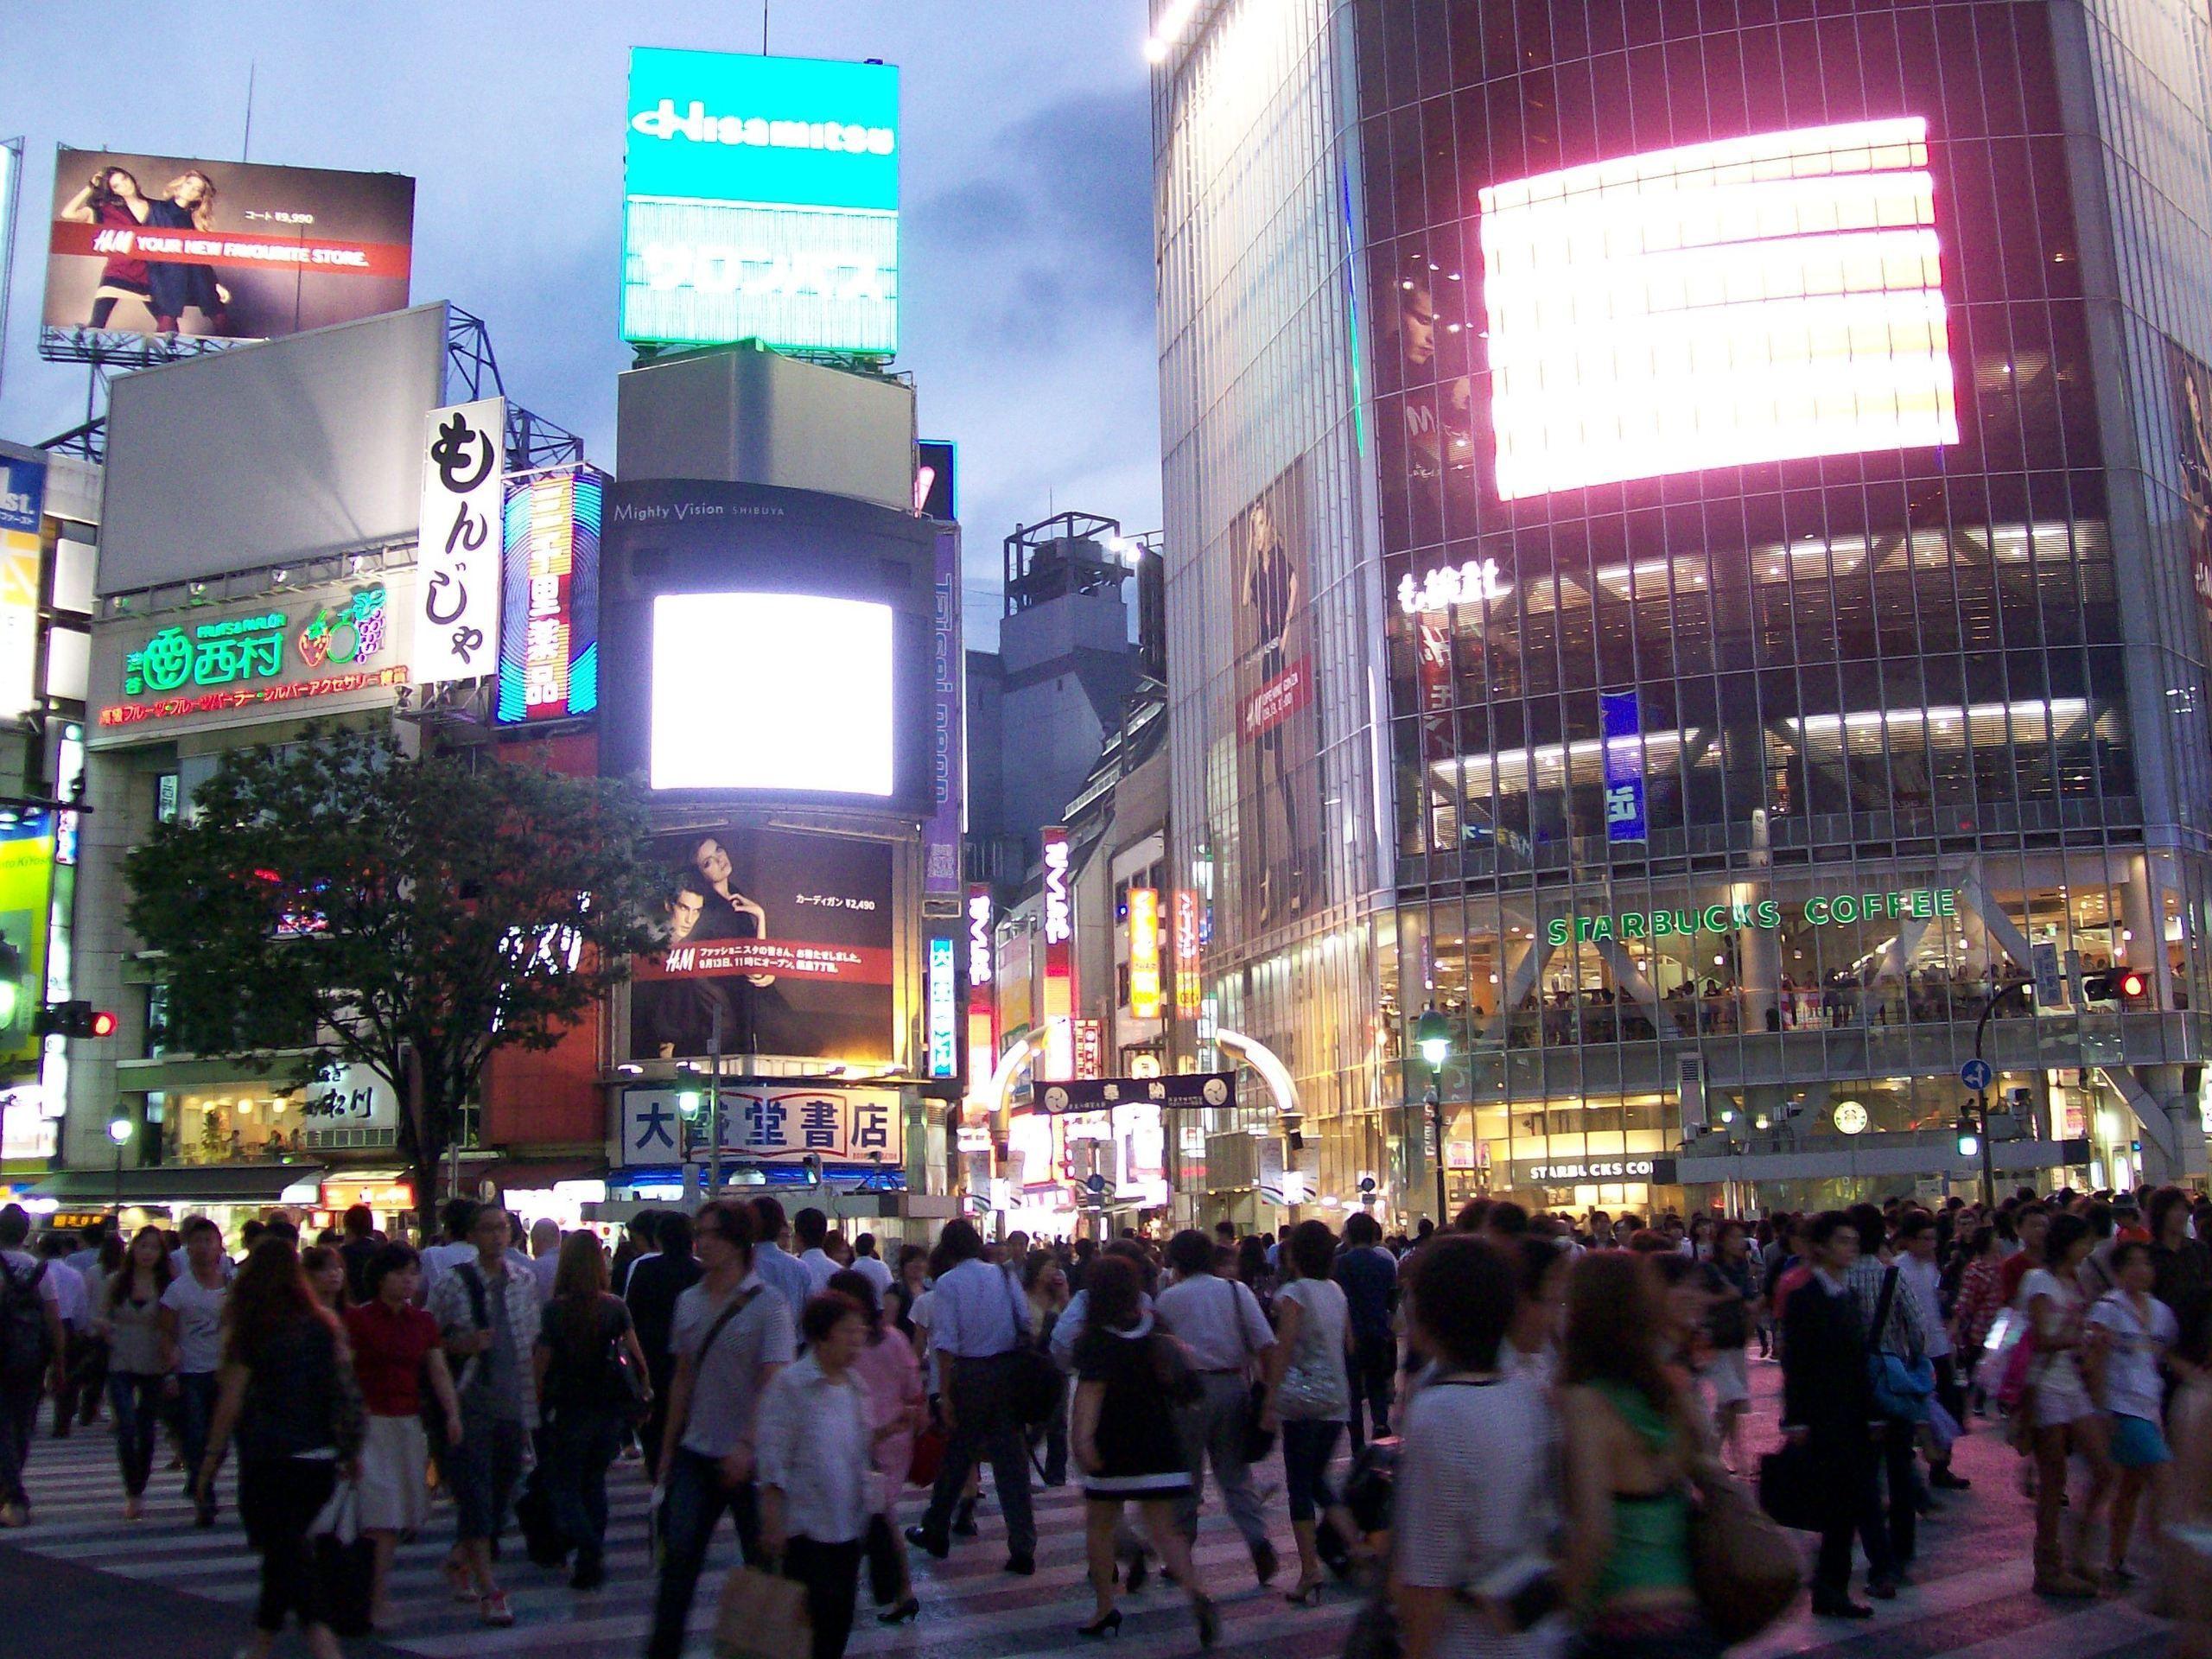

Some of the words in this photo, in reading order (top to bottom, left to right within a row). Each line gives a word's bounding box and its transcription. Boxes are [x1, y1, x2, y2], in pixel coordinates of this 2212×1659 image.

[632, 99, 894, 156] Hisamitsu
[245, 210, 271, 221] コート
[137, 236, 183, 254] YOUR
[184, 238, 223, 257] NEW
[224, 243, 308, 264] FAVOURITE
[613, 503, 670, 521] Mighty
[674, 503, 724, 520] Vision
[732, 506, 785, 516] SHIBUYA
[194, 632, 283, 685] 西村
[796, 893, 843, 907] カーディガン
[845, 899, 875, 911] ¥2,490
[1548, 900, 1782, 946] STARBUCKS
[1804, 887, 1956, 926] COFFEE
[665, 948, 696, 973] H&M
[1529, 1162, 1623, 1179] STARBUCKS
